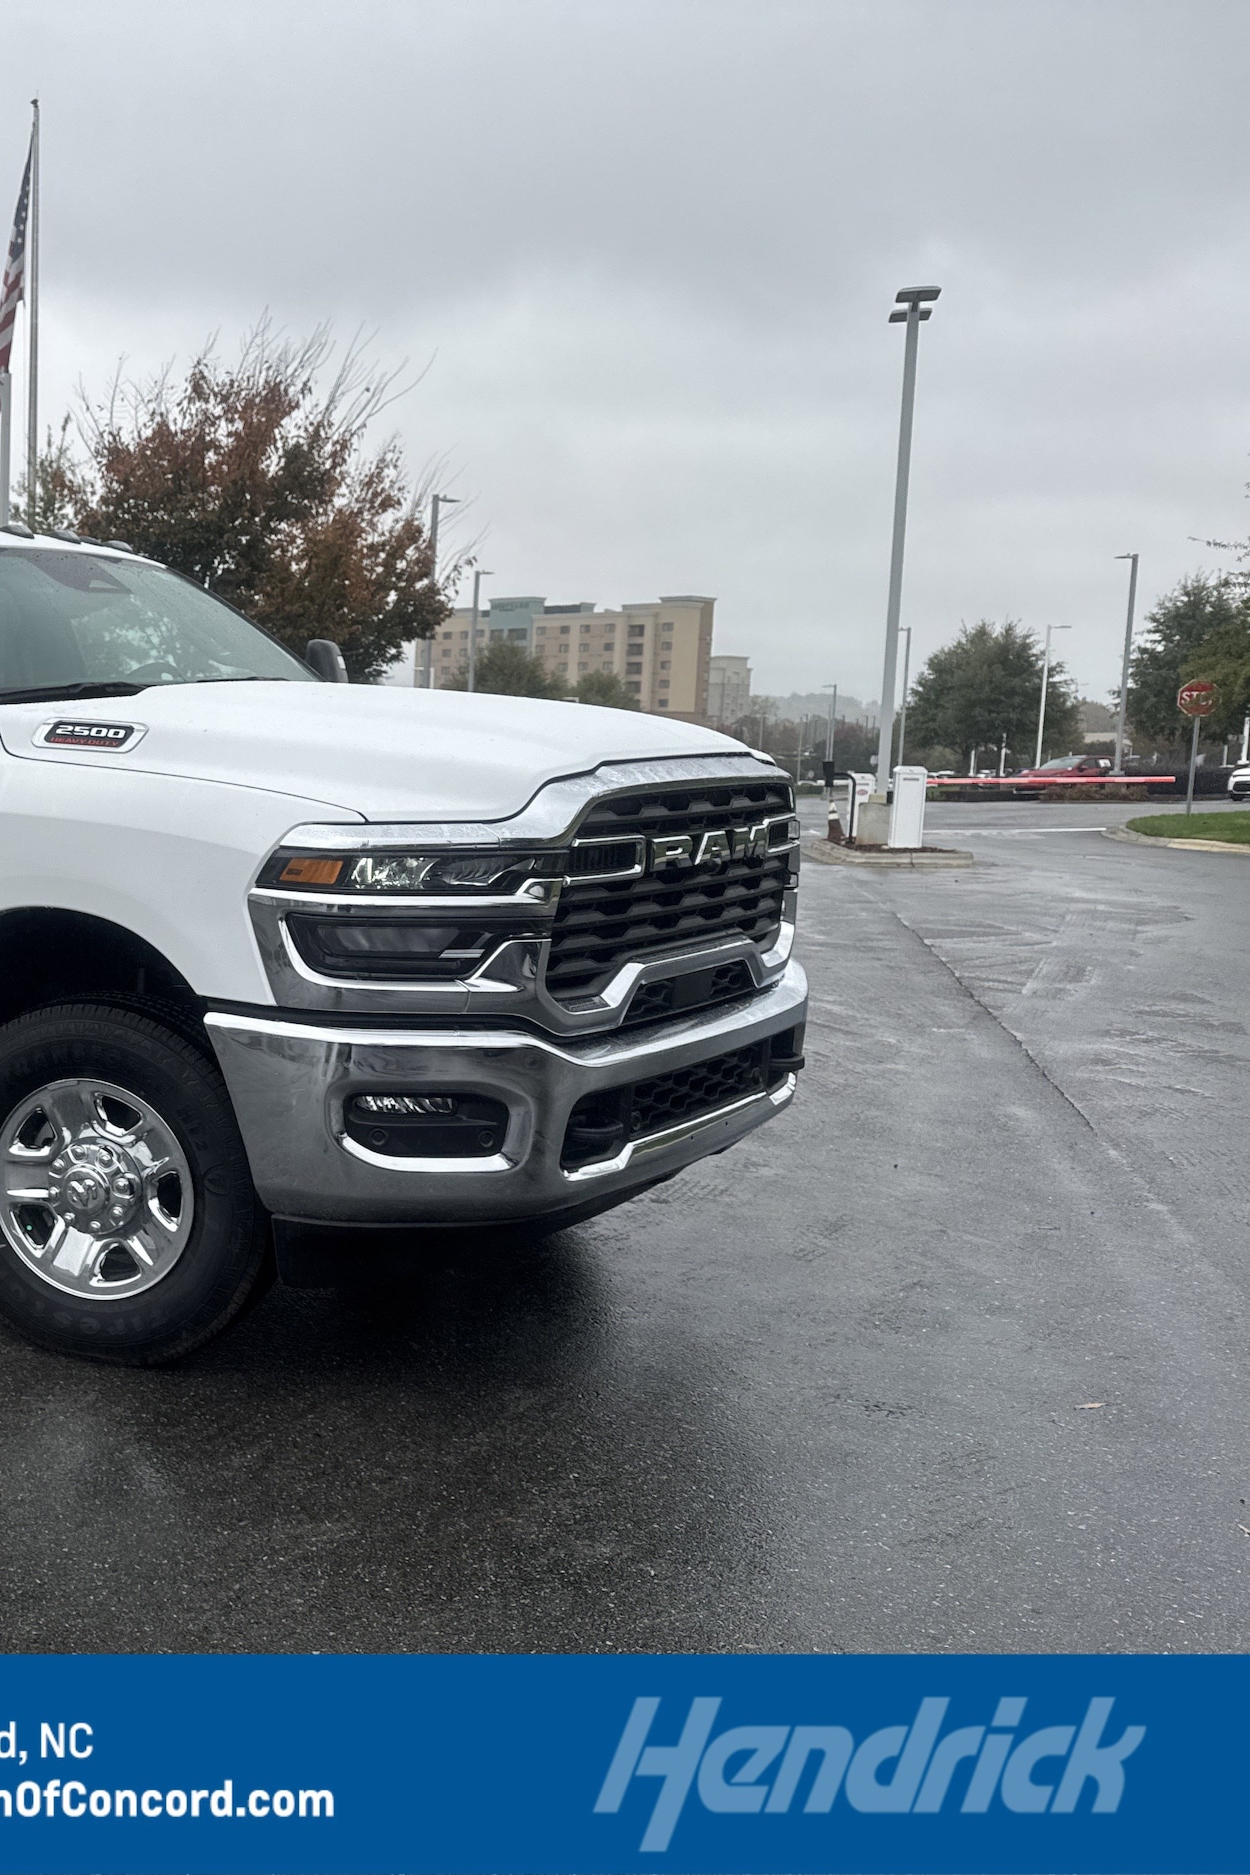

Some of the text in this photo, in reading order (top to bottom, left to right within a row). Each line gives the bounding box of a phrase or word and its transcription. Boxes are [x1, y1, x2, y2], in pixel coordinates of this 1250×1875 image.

[1181, 691, 1217, 705] ST
[55, 725, 126, 738] 2500
[51, 737, 86, 745] HEAVY
[652, 826, 768, 872] RAM
